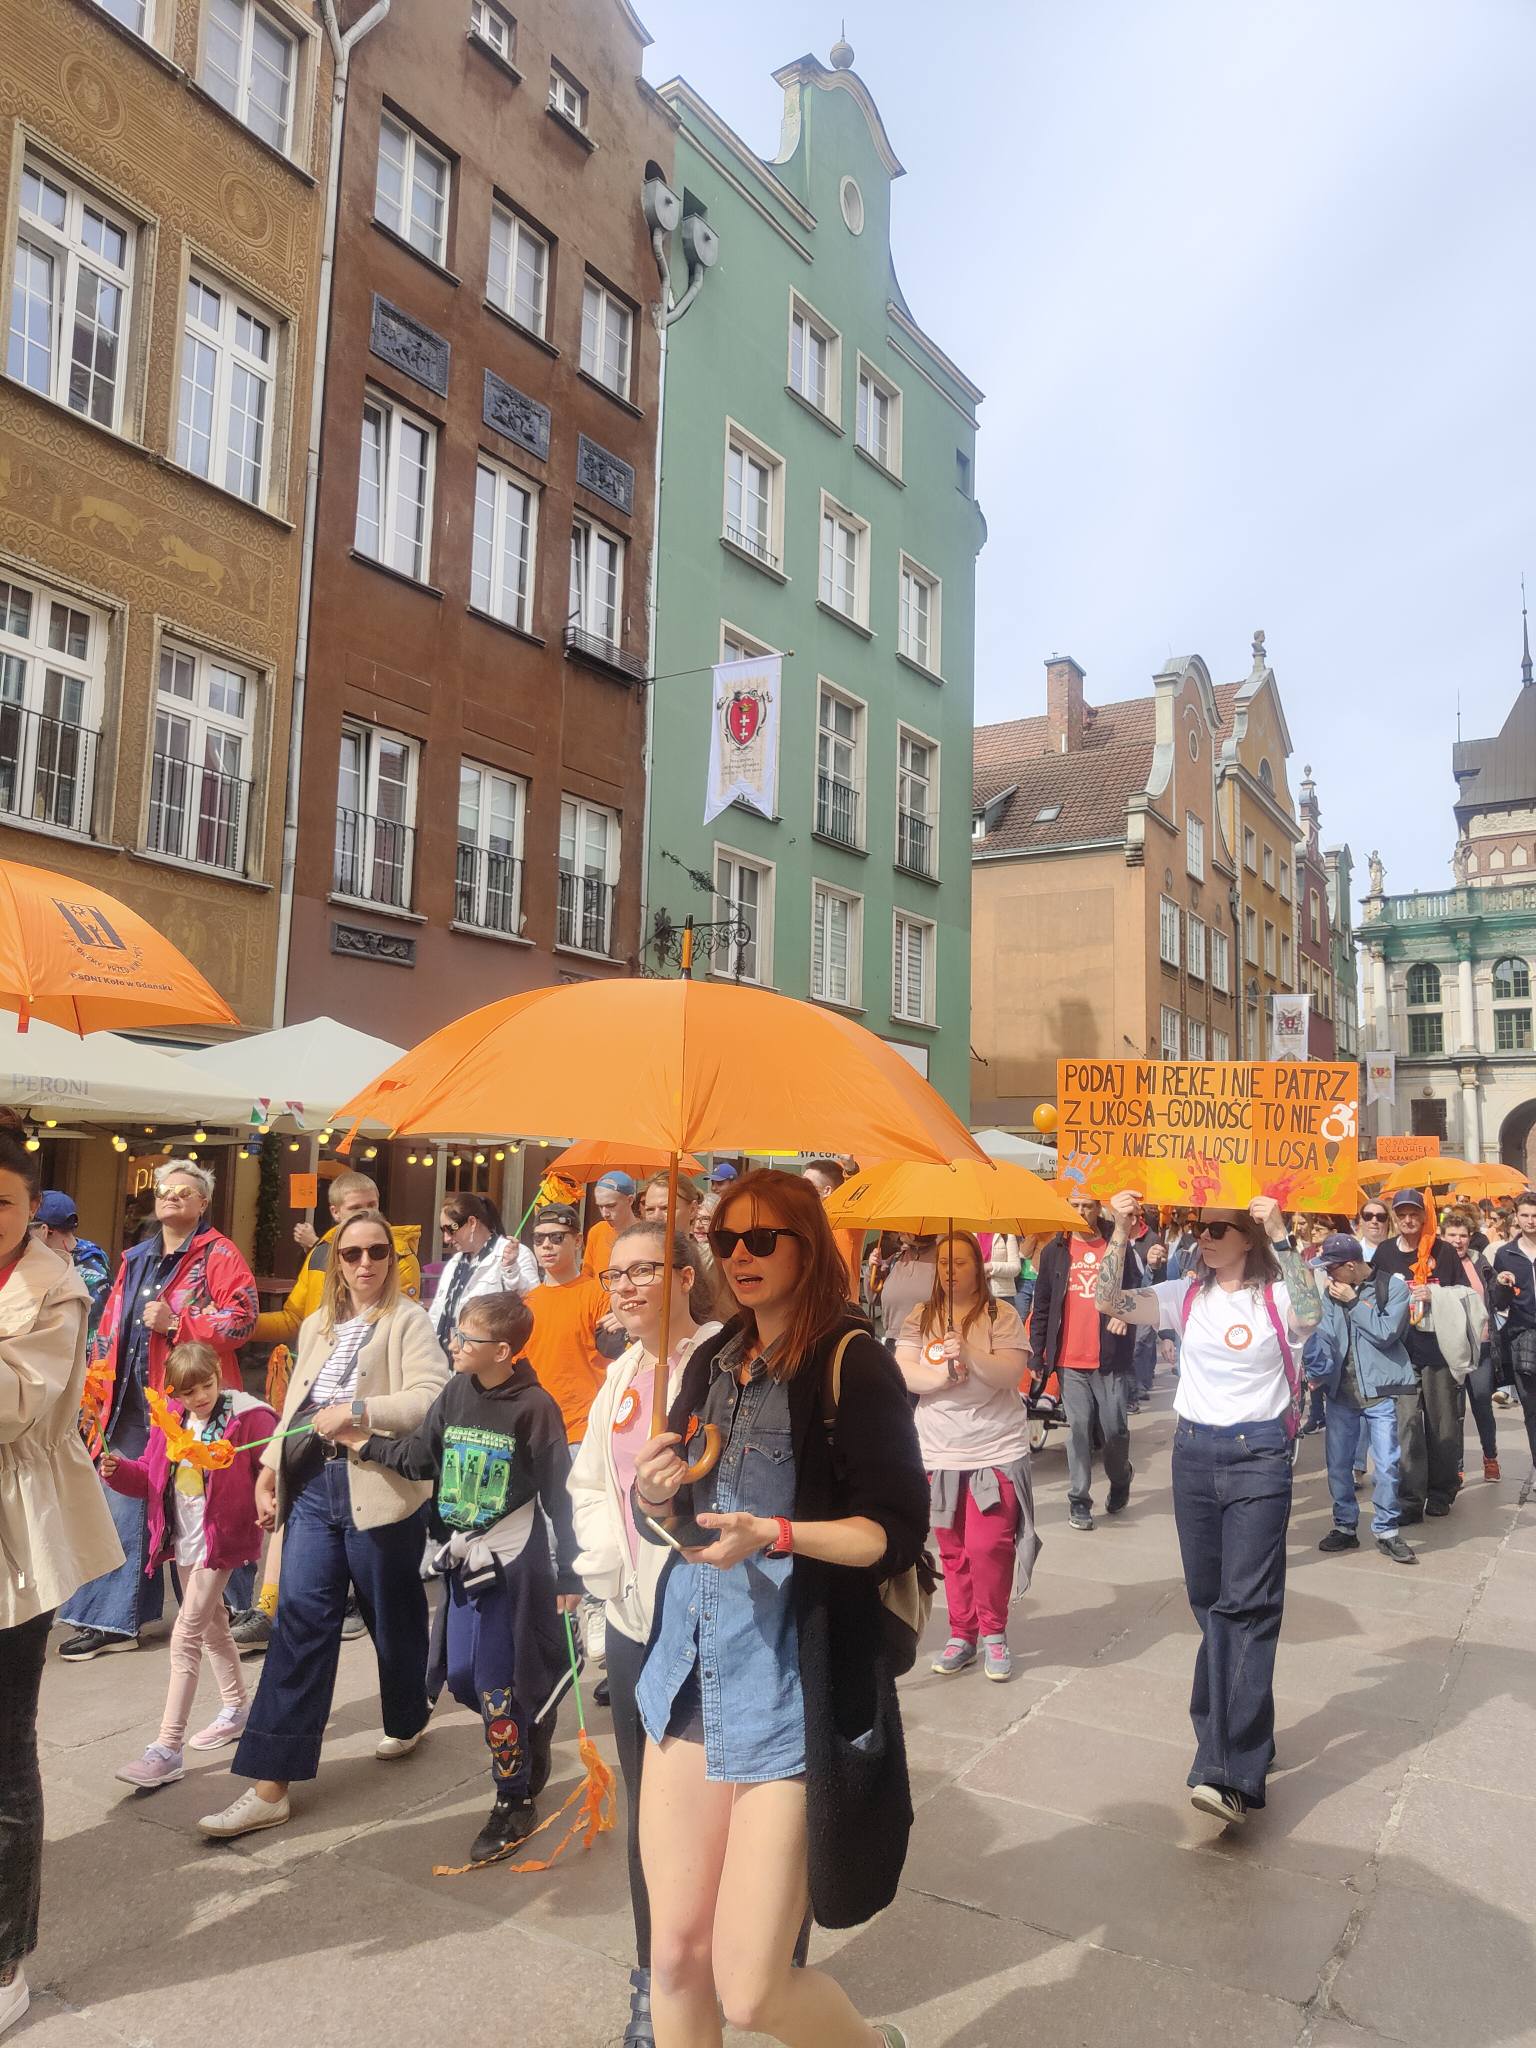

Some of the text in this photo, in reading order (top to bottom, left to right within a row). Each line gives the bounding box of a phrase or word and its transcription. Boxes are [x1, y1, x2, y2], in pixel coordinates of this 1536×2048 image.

[12, 1073, 88, 1096] PERONI
[1065, 1064, 1125, 1099] PODAJ
[1136, 1065, 1157, 1095] MI
[1162, 1066, 1216, 1099] RĘKĘ
[1231, 1068, 1264, 1098] NIE
[1274, 1068, 1351, 1101] PATRZ
[1063, 1100, 1083, 1125] Z
[1260, 1102, 1285, 1132] TO
[1290, 1104, 1321, 1135] NIE
[1062, 1129, 1115, 1161] JEST
[1122, 1131, 1197, 1160] KWESTIA
[1203, 1136, 1249, 1165] LOSU
[444, 1425, 517, 1454] MINECRAFT
